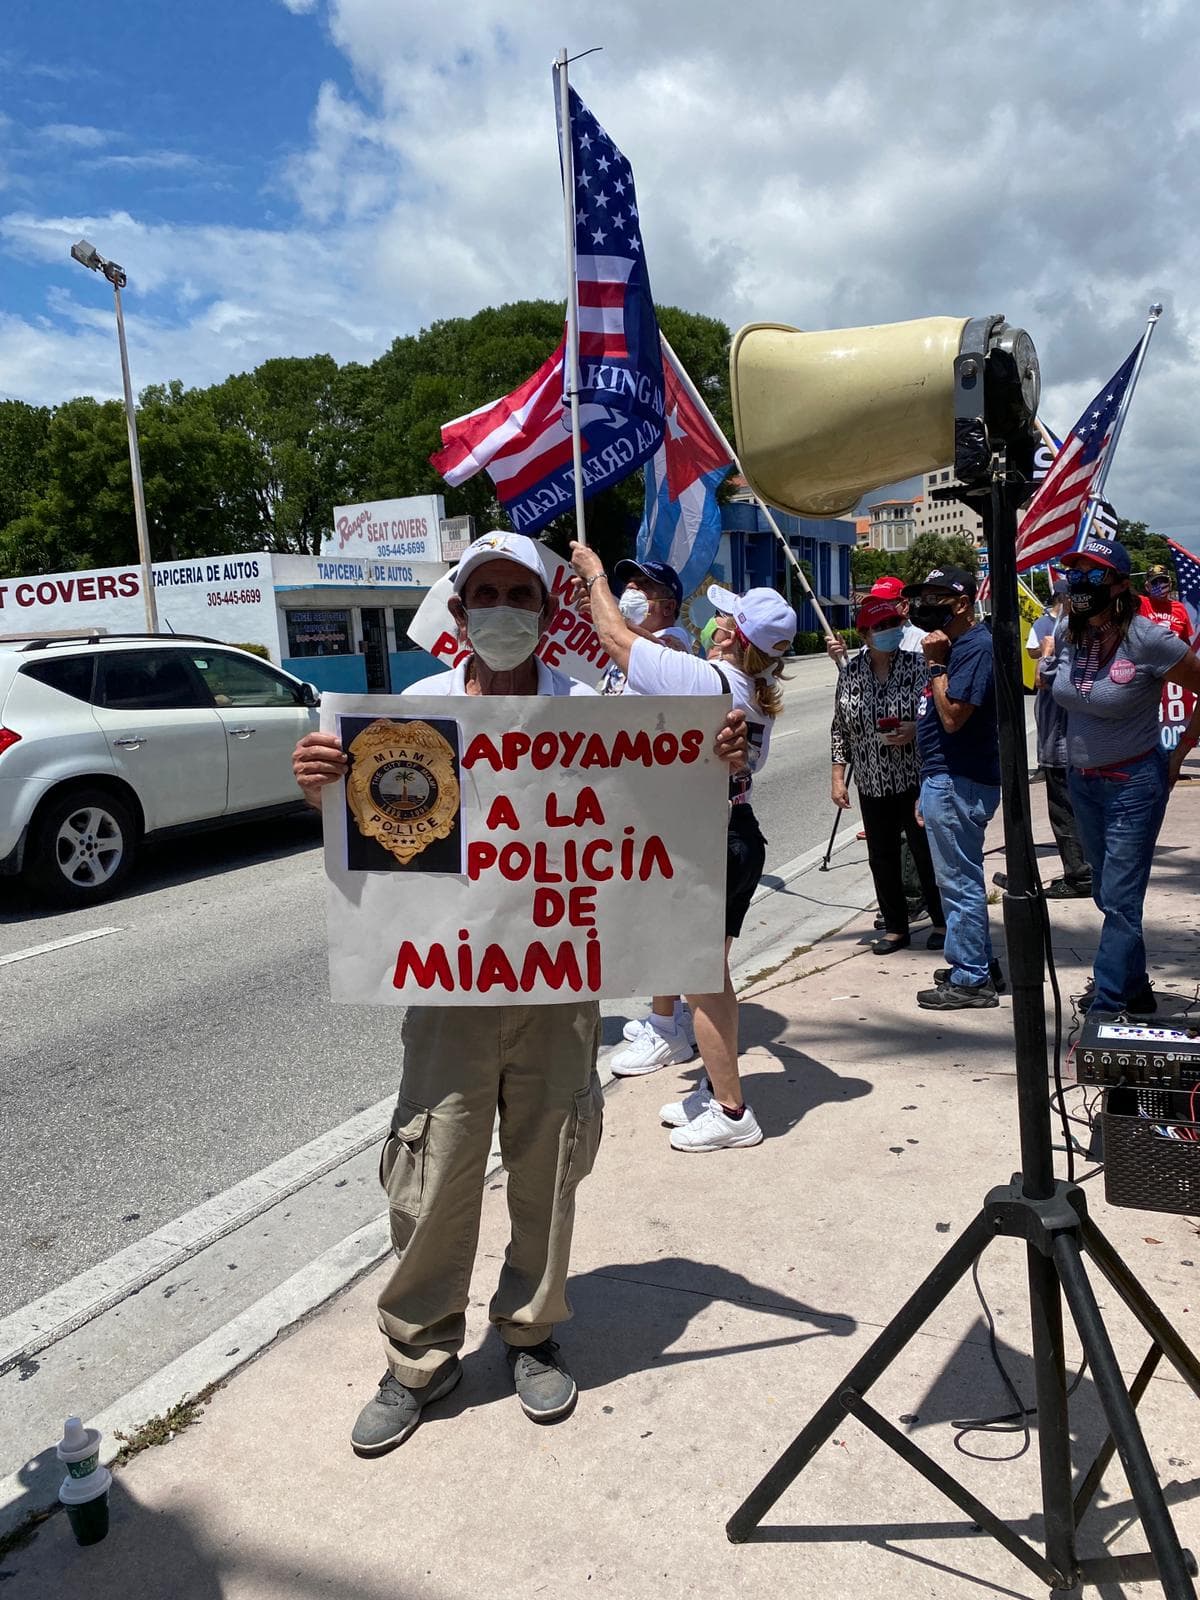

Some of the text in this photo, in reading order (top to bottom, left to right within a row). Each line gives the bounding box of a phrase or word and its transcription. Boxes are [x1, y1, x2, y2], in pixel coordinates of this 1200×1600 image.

[336, 510, 372, 549] Ranger
[367, 521, 388, 543] SEAT
[391, 517, 428, 540] COVERS
[376, 541, 426, 557] 305-445-6699
[152, 561, 259, 587] TAPICERIA DE AUTOS
[317, 563, 413, 582] TAPICERIA DE AUTOS
[15, 573, 140, 607] COVERS
[207, 589, 261, 606] 305-445-6699
[373, 749, 434, 766] MIAMI
[461, 729, 704, 772] APOYAMOS
[486, 786, 605, 830] A LA
[370, 814, 439, 835] POLICE
[532, 886, 597, 928] DE
